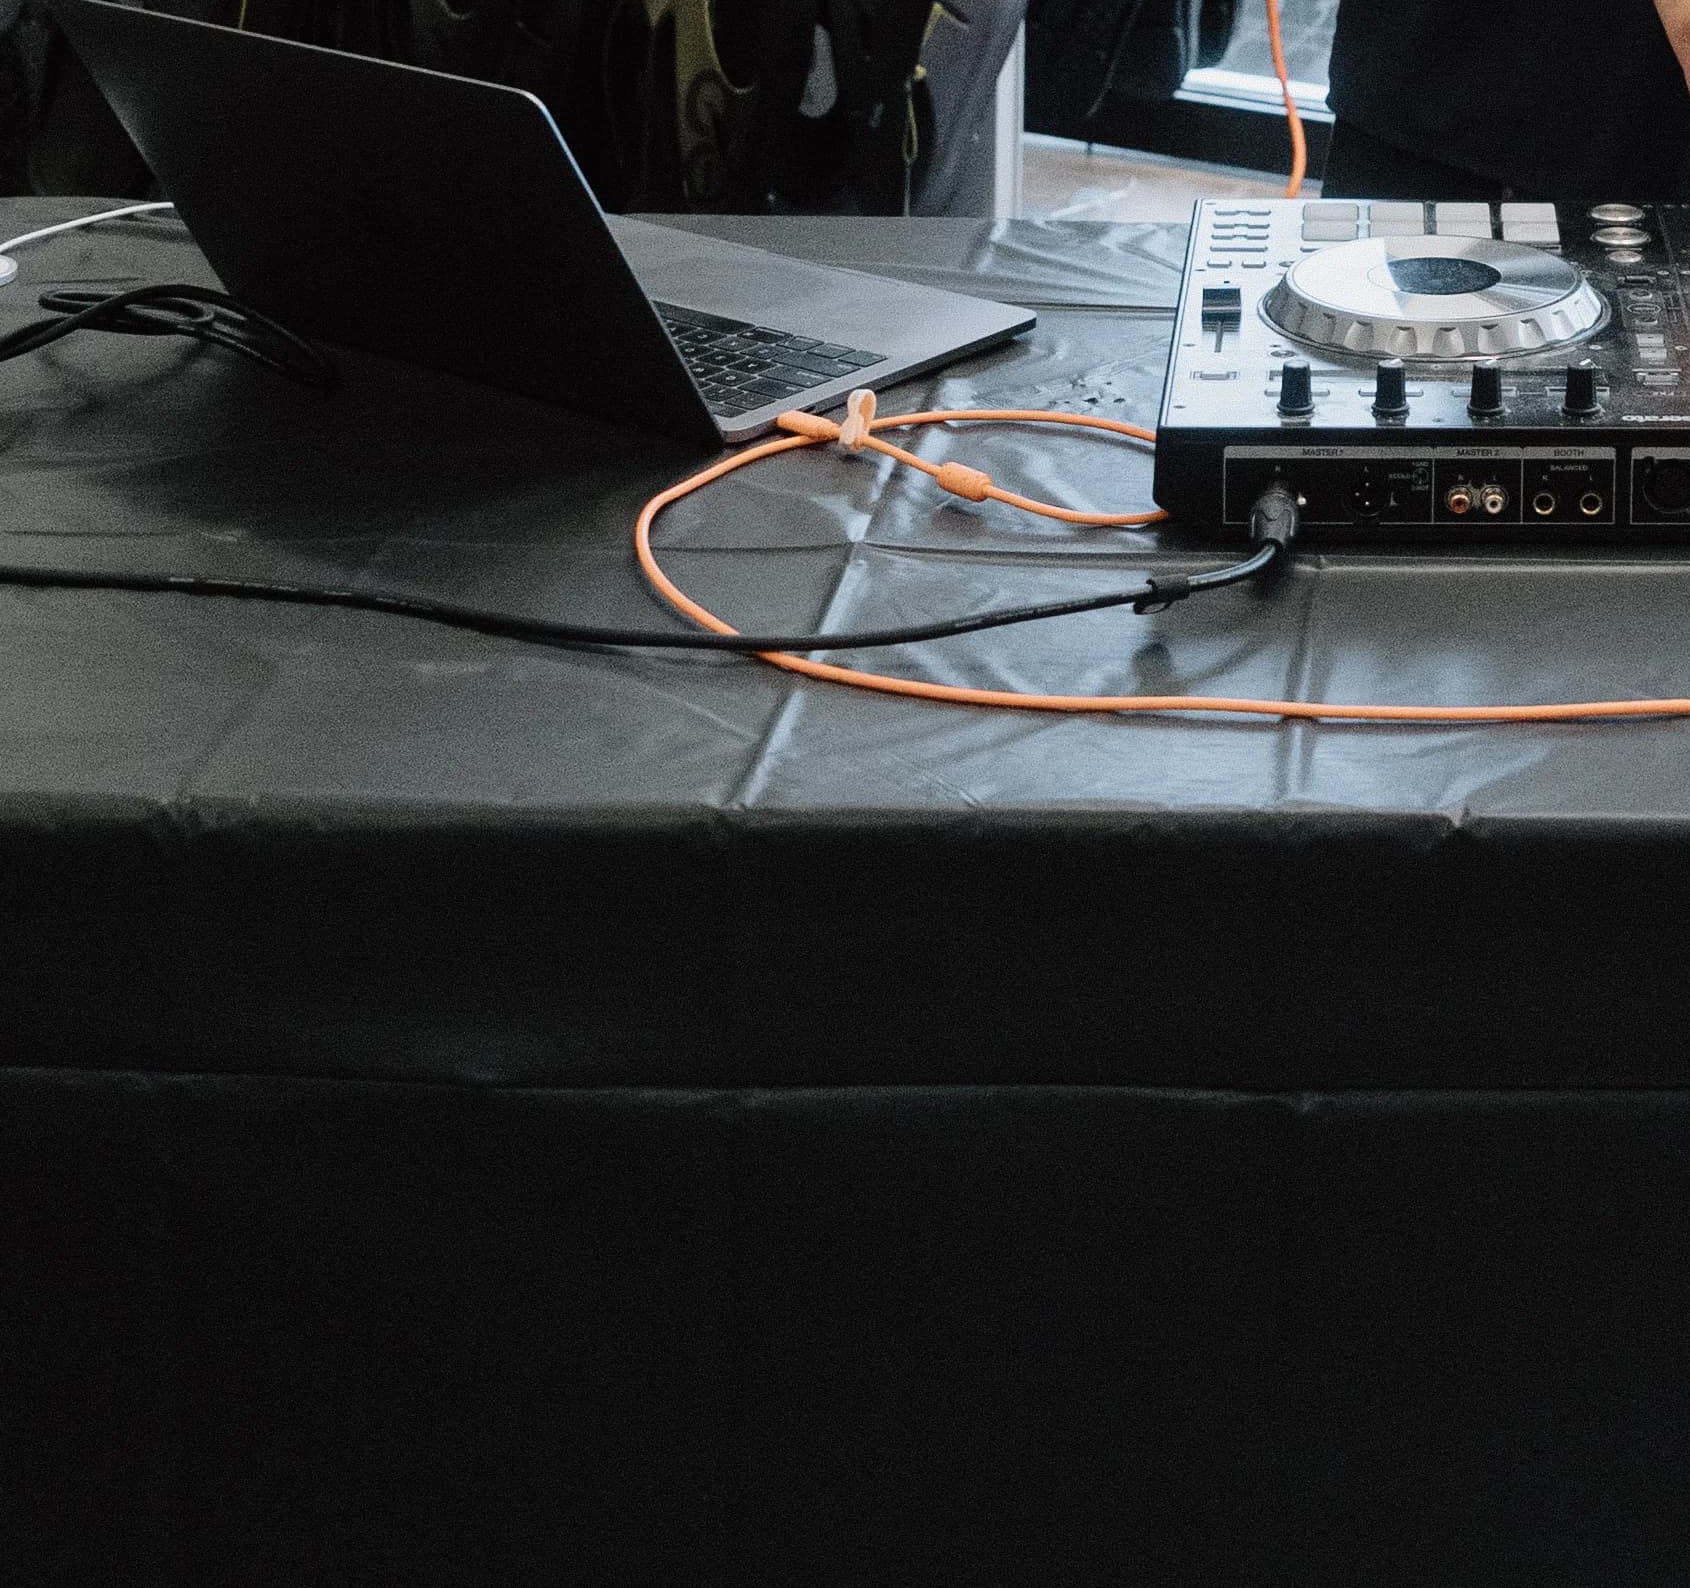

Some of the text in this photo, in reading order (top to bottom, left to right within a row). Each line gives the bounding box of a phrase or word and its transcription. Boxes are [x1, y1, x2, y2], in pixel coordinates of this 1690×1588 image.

[1302, 448, 1338, 457] MASTER
[1456, 449, 1494, 457] MASTER
[1553, 449, 1585, 457] BOOTH
